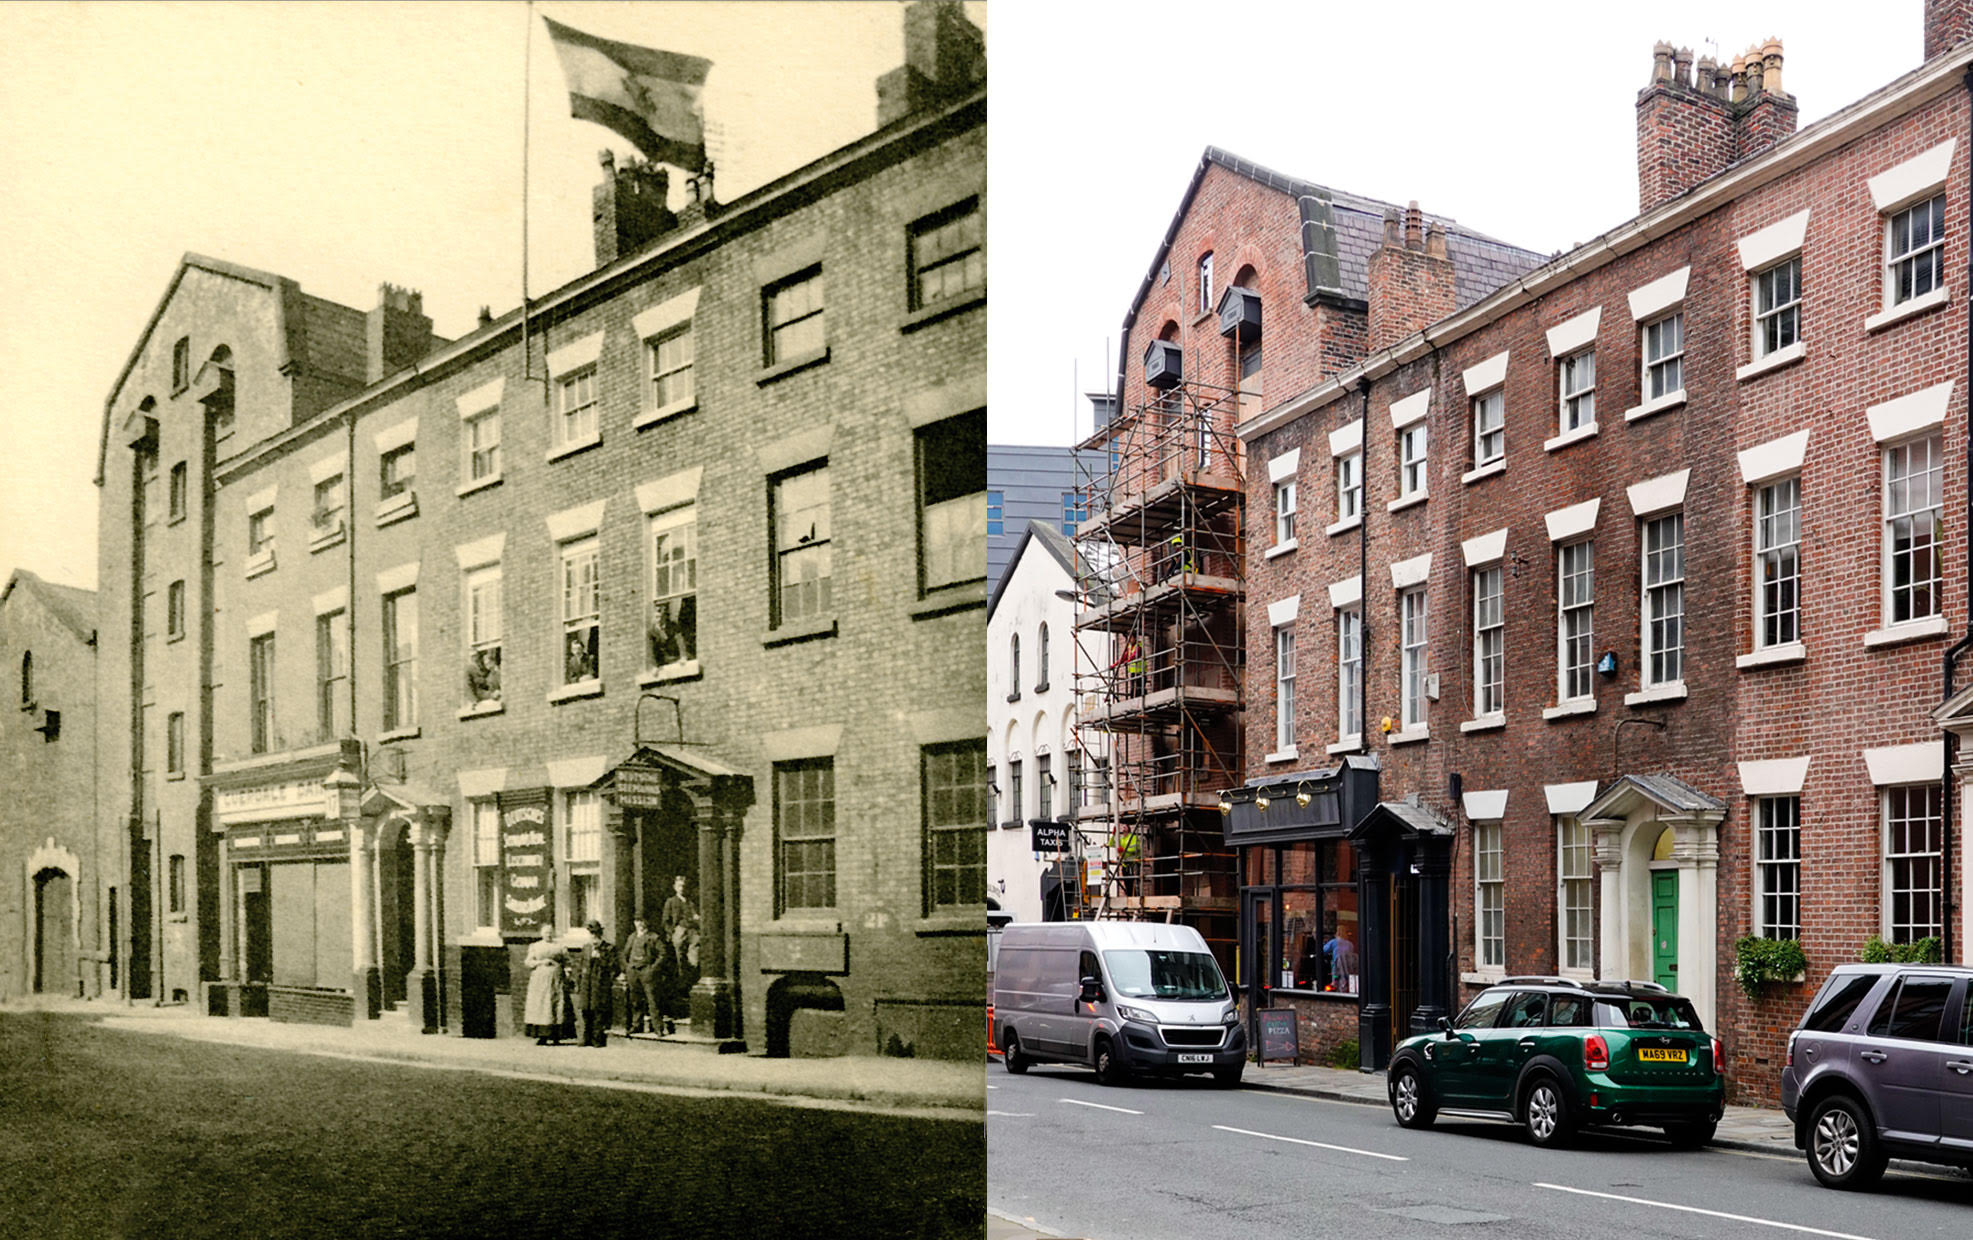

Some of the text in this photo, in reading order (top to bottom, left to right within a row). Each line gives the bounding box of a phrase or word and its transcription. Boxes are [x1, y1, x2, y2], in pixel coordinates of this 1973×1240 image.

[619, 795, 658, 805] MISSION
[1037, 828, 1066, 837] ALPHA
[1268, 1027, 1290, 1035] PIZZA
[1642, 1049, 1684, 1060] MA69 VRZ
